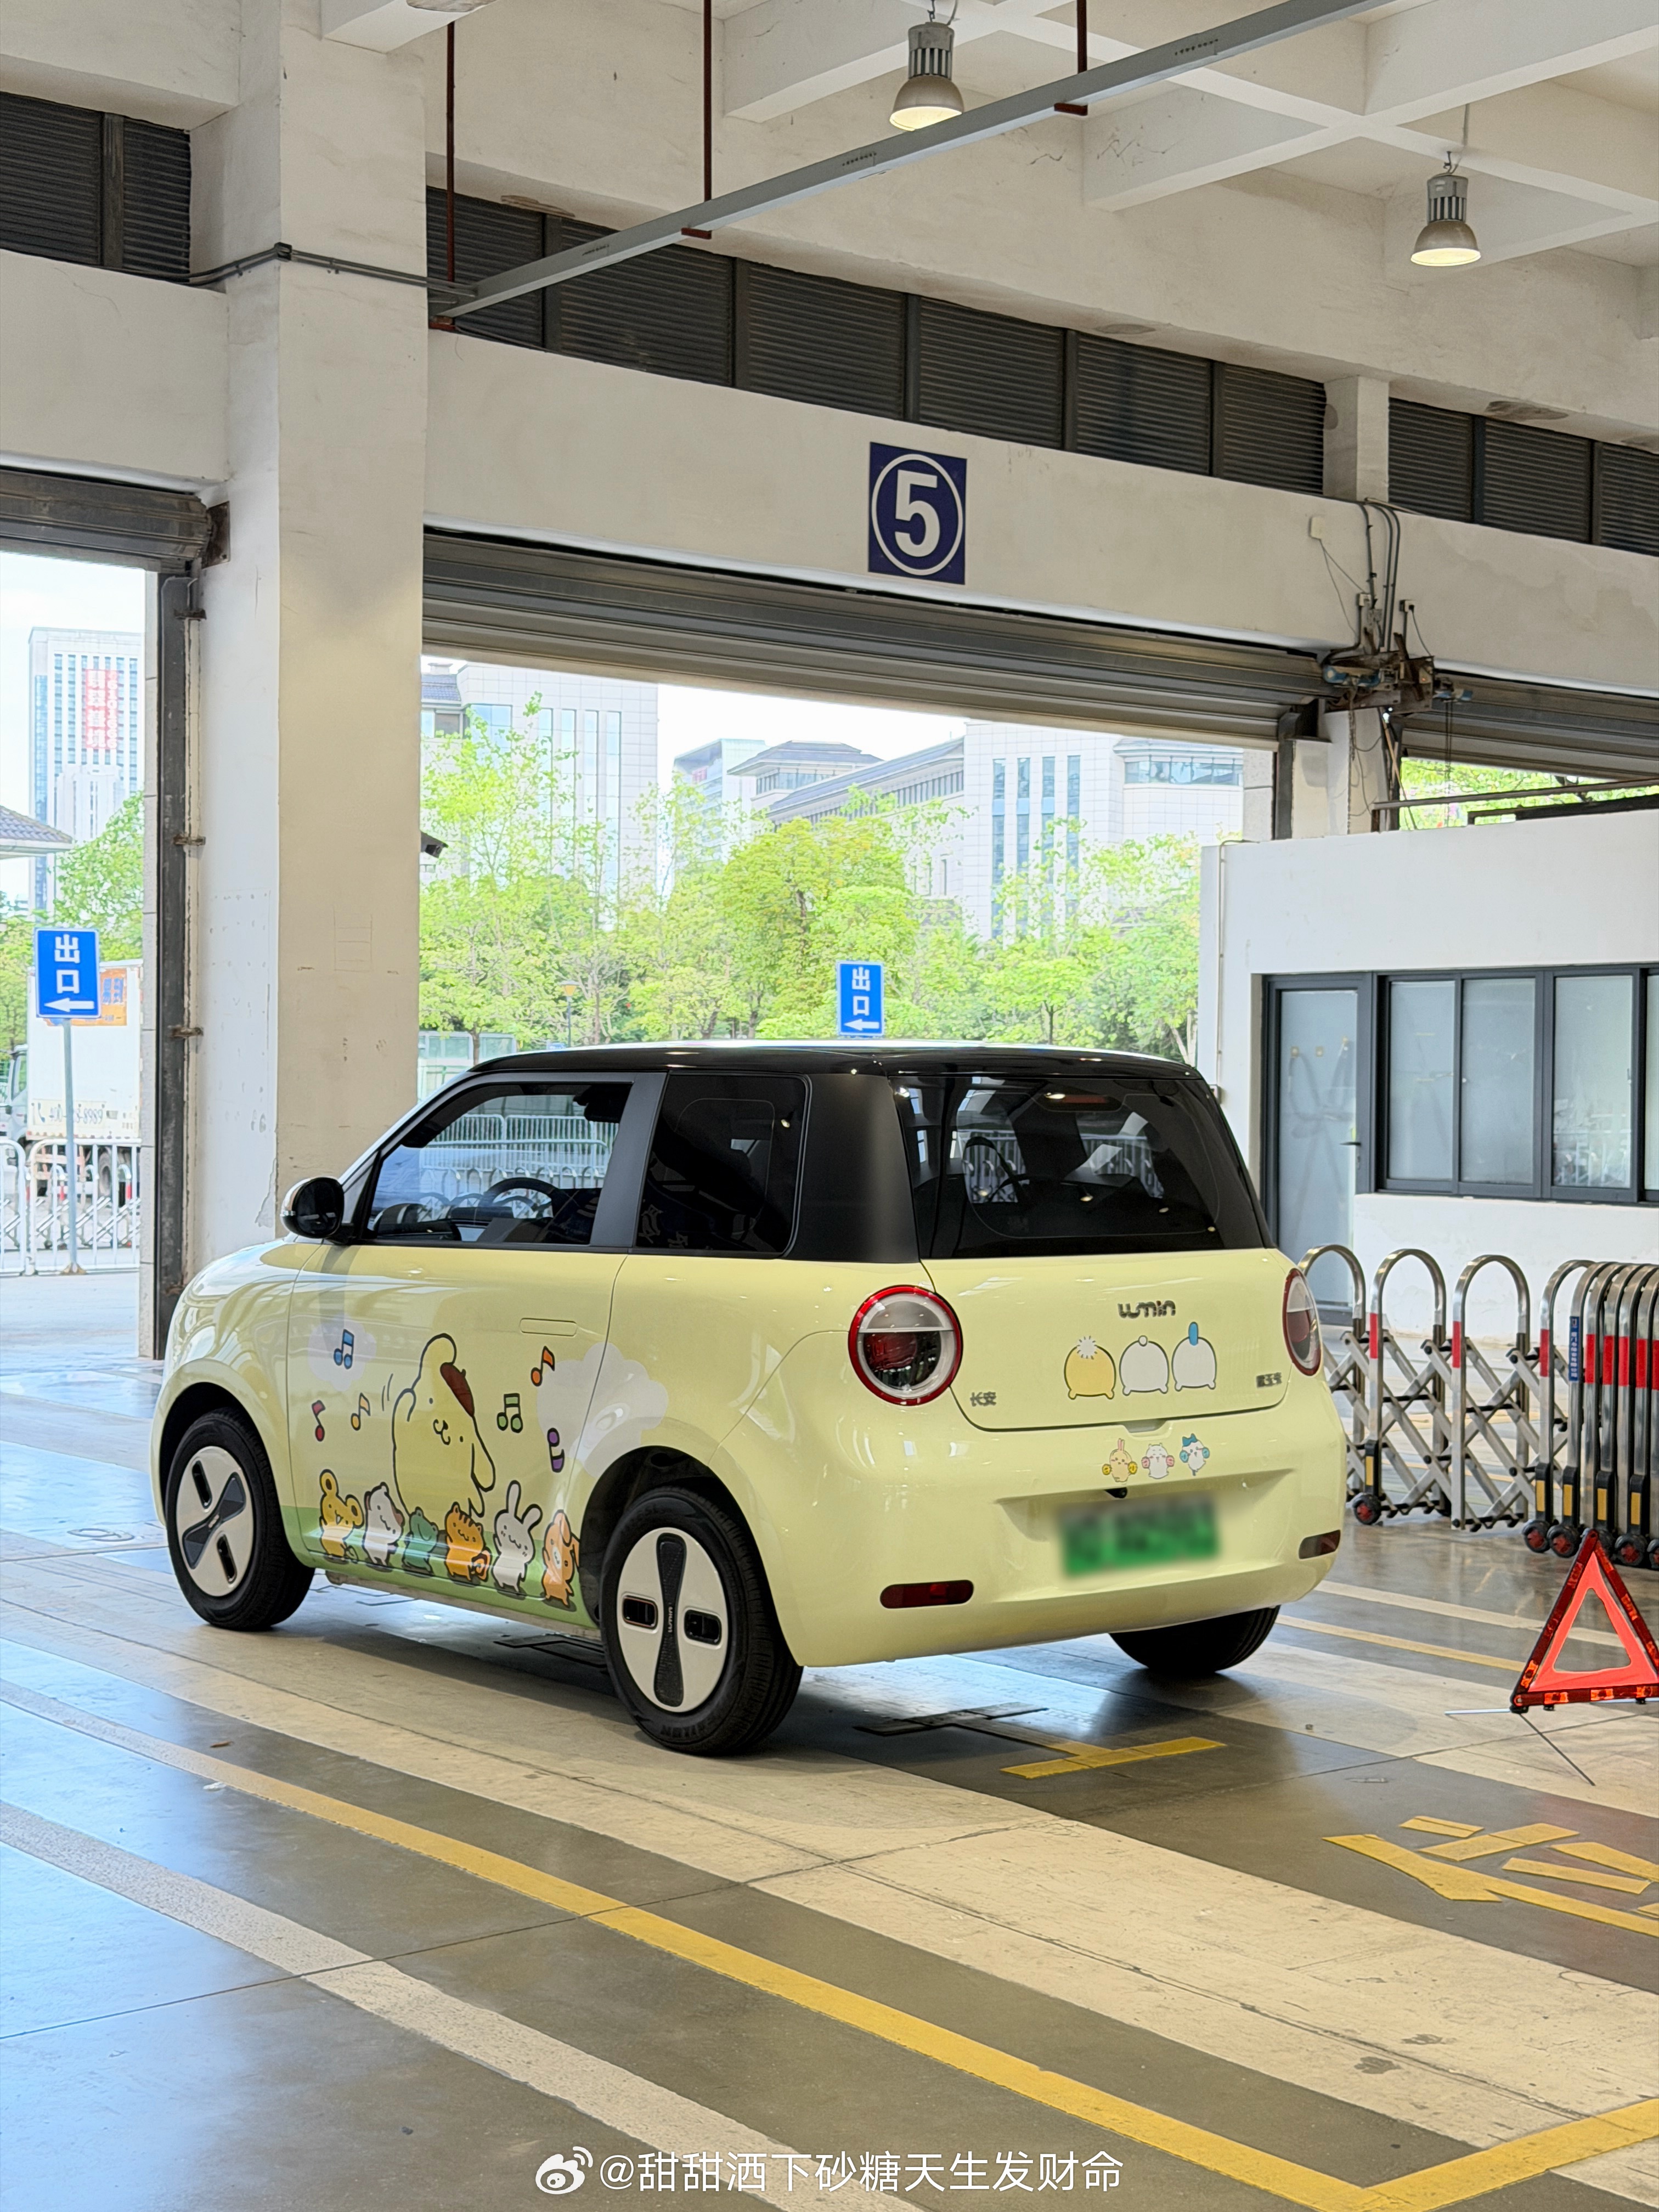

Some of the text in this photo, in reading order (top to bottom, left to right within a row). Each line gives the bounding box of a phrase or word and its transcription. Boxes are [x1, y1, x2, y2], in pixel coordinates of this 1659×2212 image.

[895, 469, 940, 557] 5
[54, 934, 80, 994] 出口
[852, 966, 871, 1016] 出口
